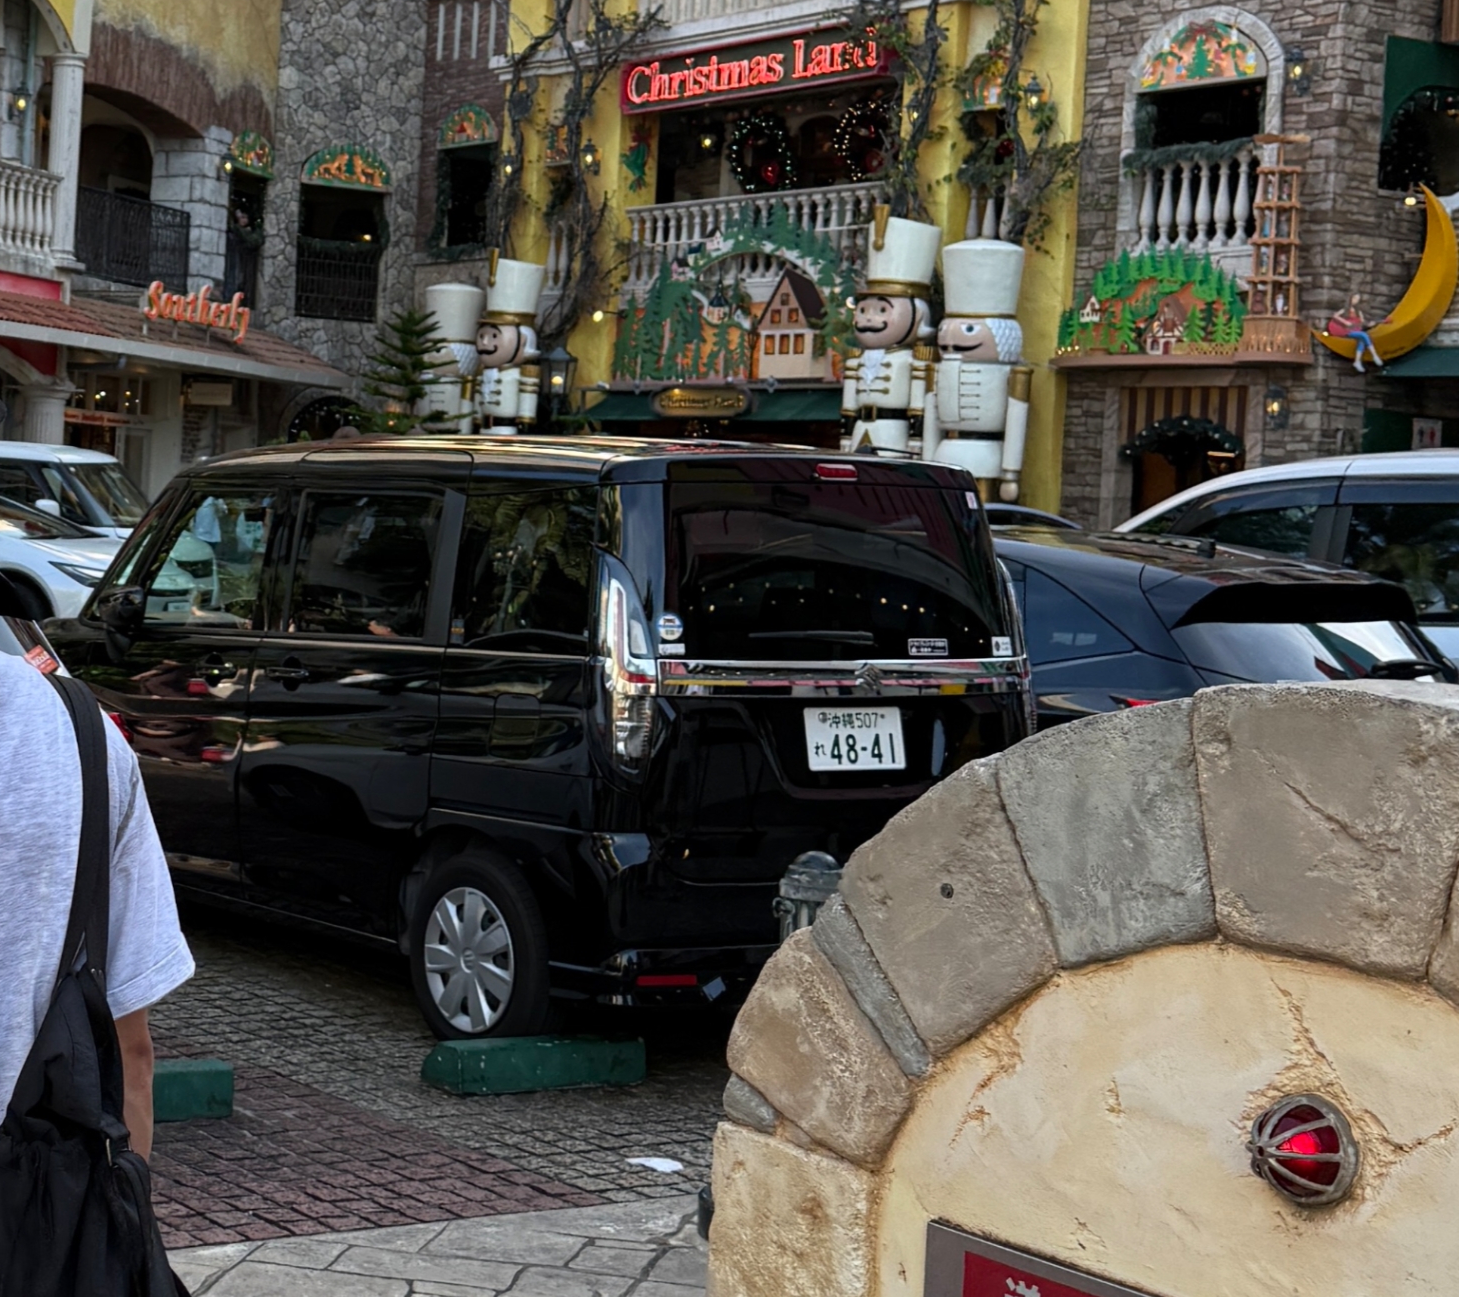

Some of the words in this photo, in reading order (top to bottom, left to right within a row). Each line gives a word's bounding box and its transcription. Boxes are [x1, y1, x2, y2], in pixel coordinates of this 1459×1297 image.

[627, 53, 785, 104] Christmas
[143, 280, 251, 345] Southerly
[830, 732, 896, 765] 48-41
